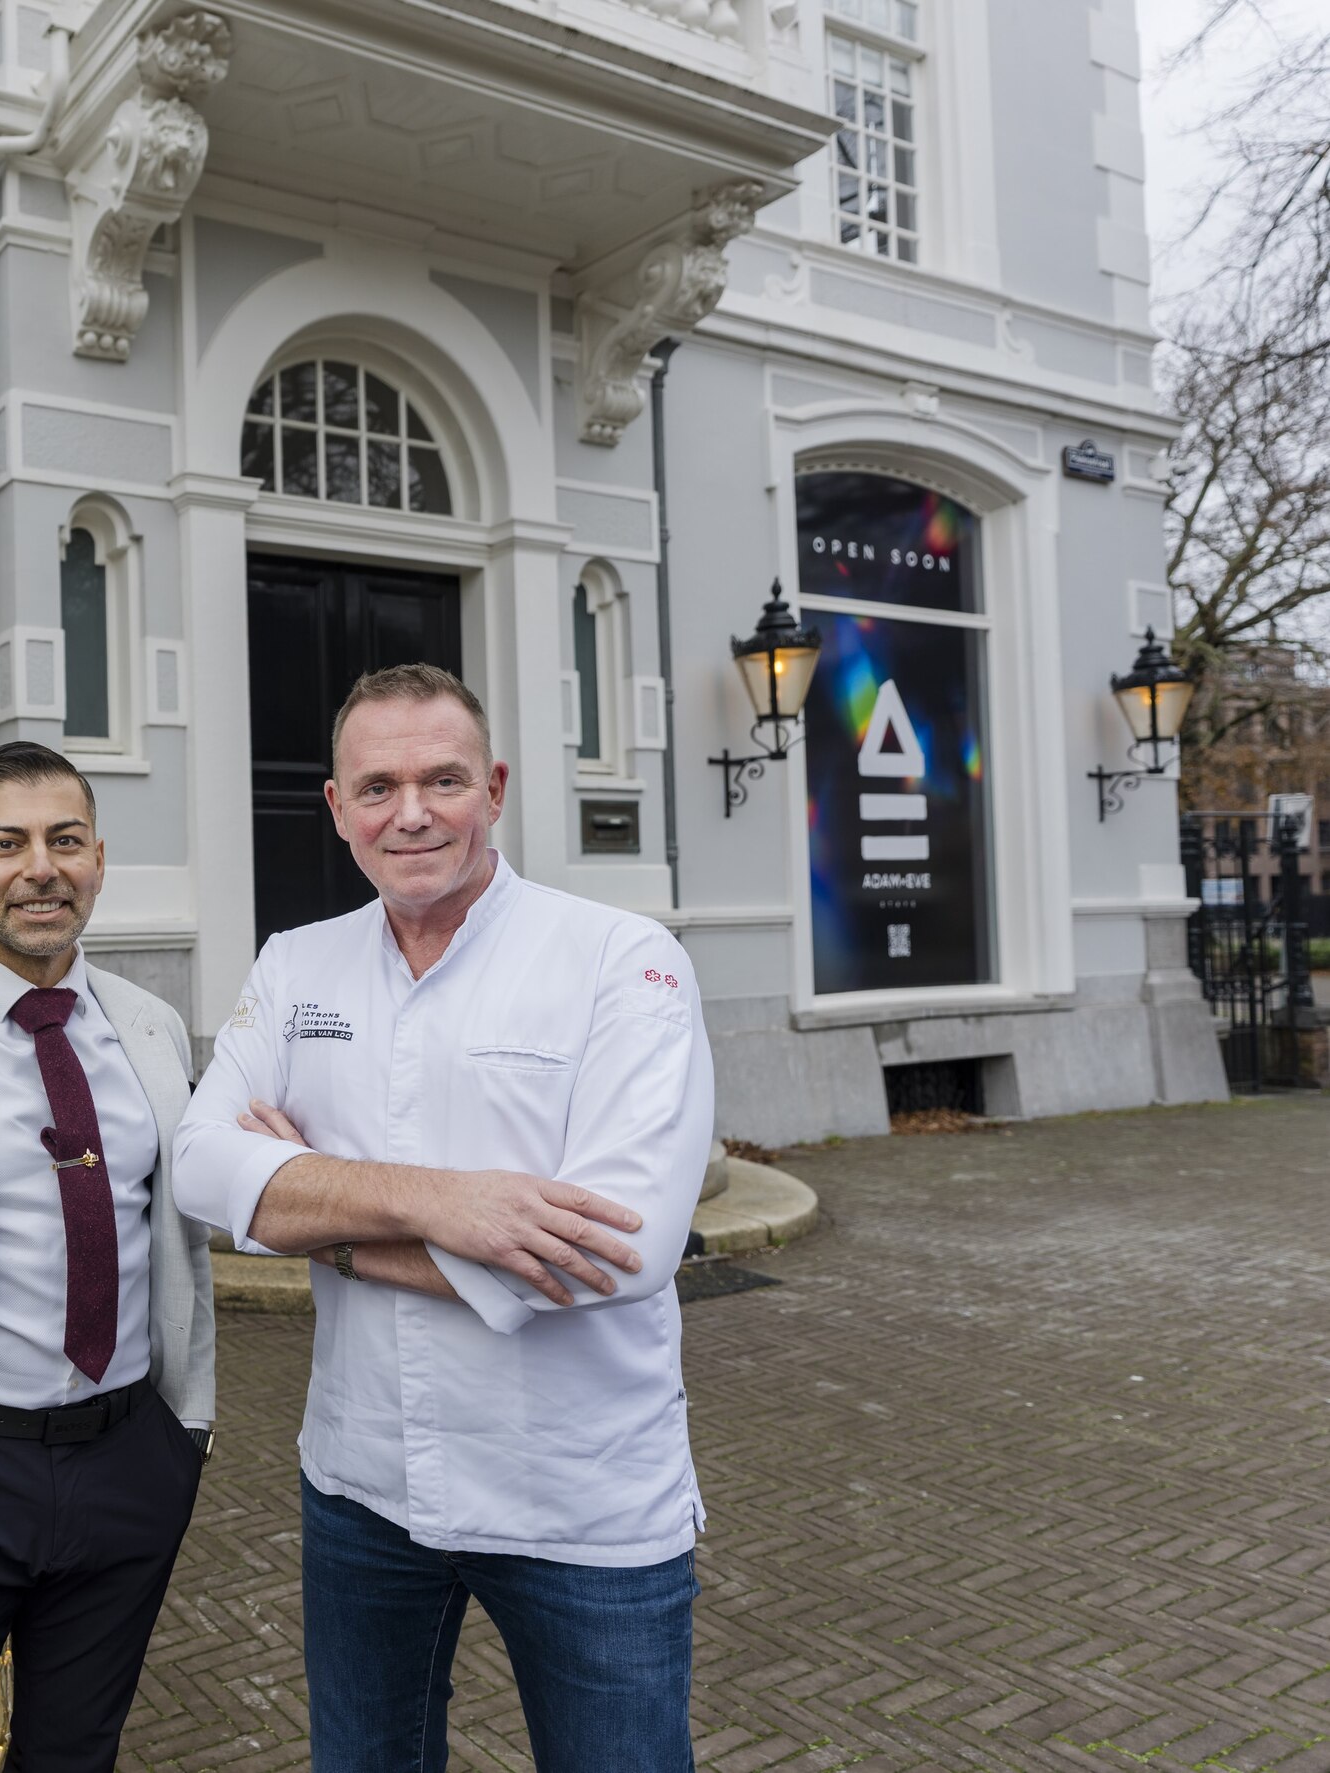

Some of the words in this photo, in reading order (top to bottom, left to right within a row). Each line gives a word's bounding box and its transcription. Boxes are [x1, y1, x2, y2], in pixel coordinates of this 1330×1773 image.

[812, 536, 875, 561] OPEN
[890, 548, 951, 573] SOON
[334, 1031, 352, 1039] LOO
